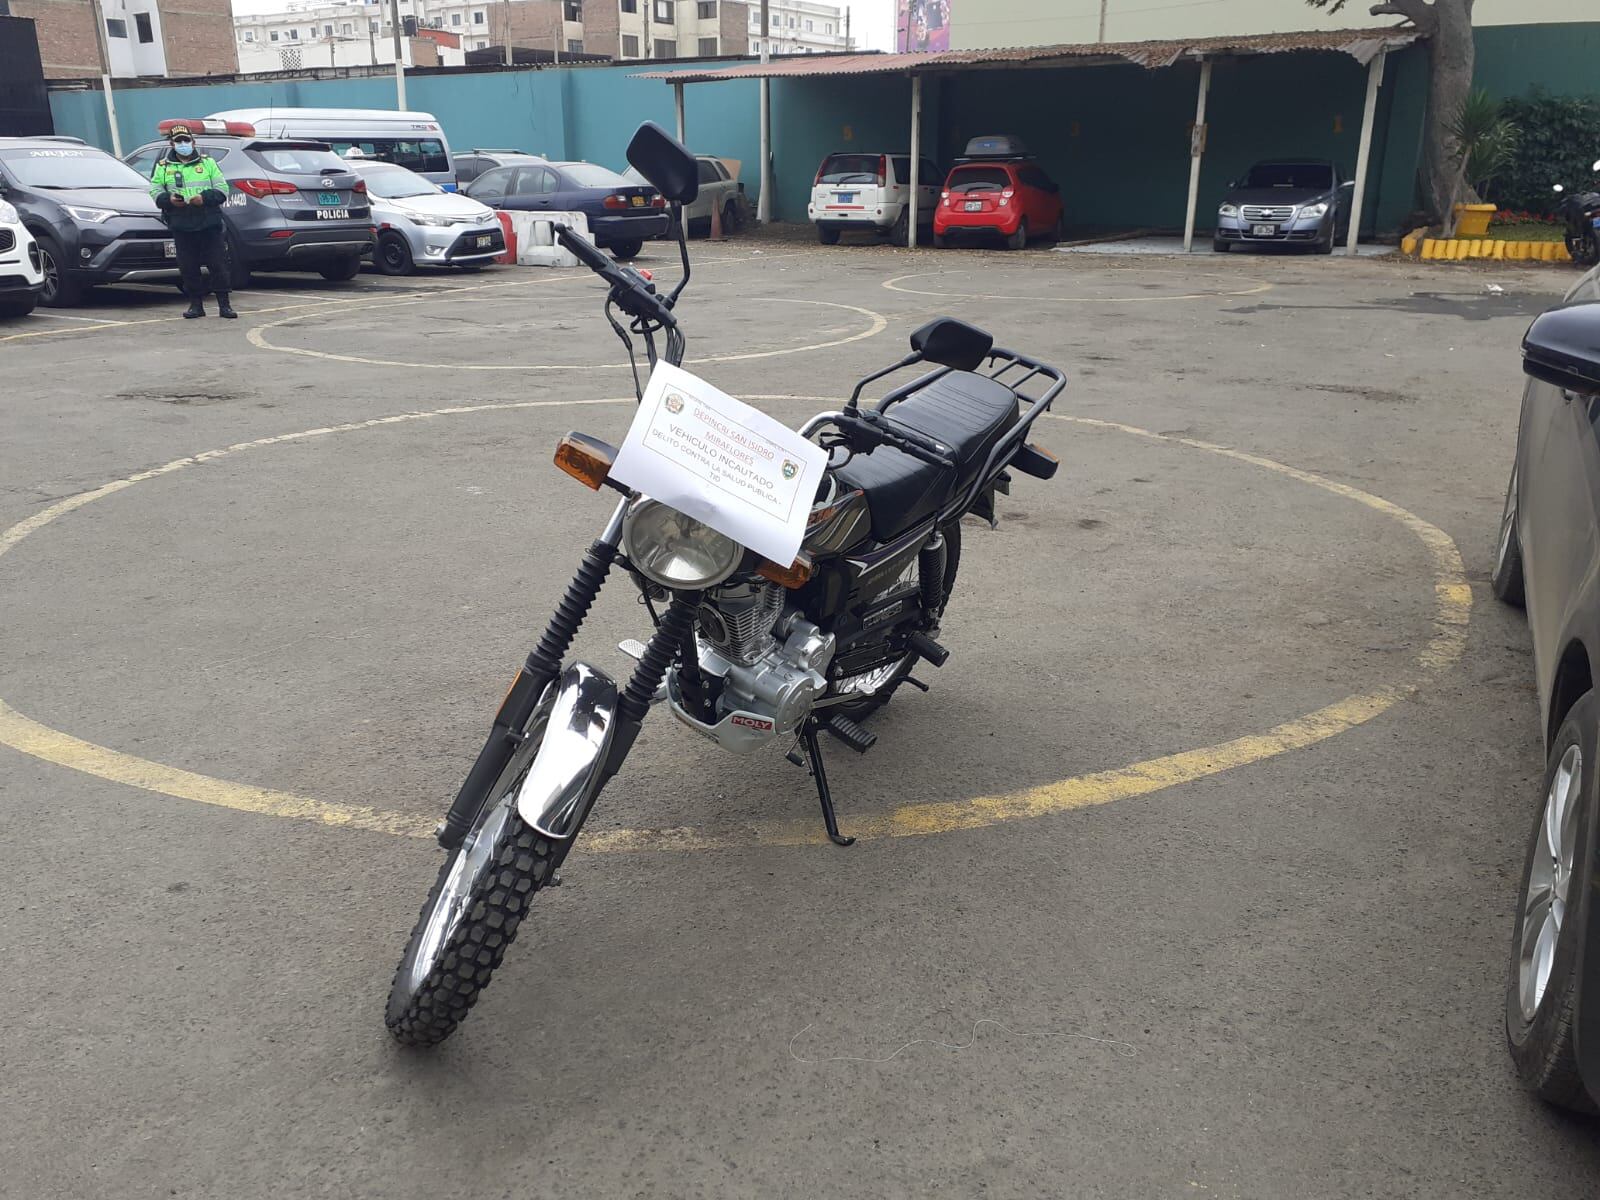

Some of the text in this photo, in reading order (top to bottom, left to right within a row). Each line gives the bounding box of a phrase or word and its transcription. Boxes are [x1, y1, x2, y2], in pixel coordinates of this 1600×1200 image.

[316, 209, 349, 220] POLICIA
[652, 428, 680, 448] DELITO
[681, 445, 710, 466] CONTRA
[711, 463, 721, 473] LA
[722, 470, 746, 487] SALUD
[670, 424, 774, 489] VEHICULO INCAUTADO
[705, 431, 754, 465] MIRAFLORES
[731, 431, 747, 445] SAN
[748, 440, 775, 460] ISIDRO
[733, 717, 770, 728] MOLY
